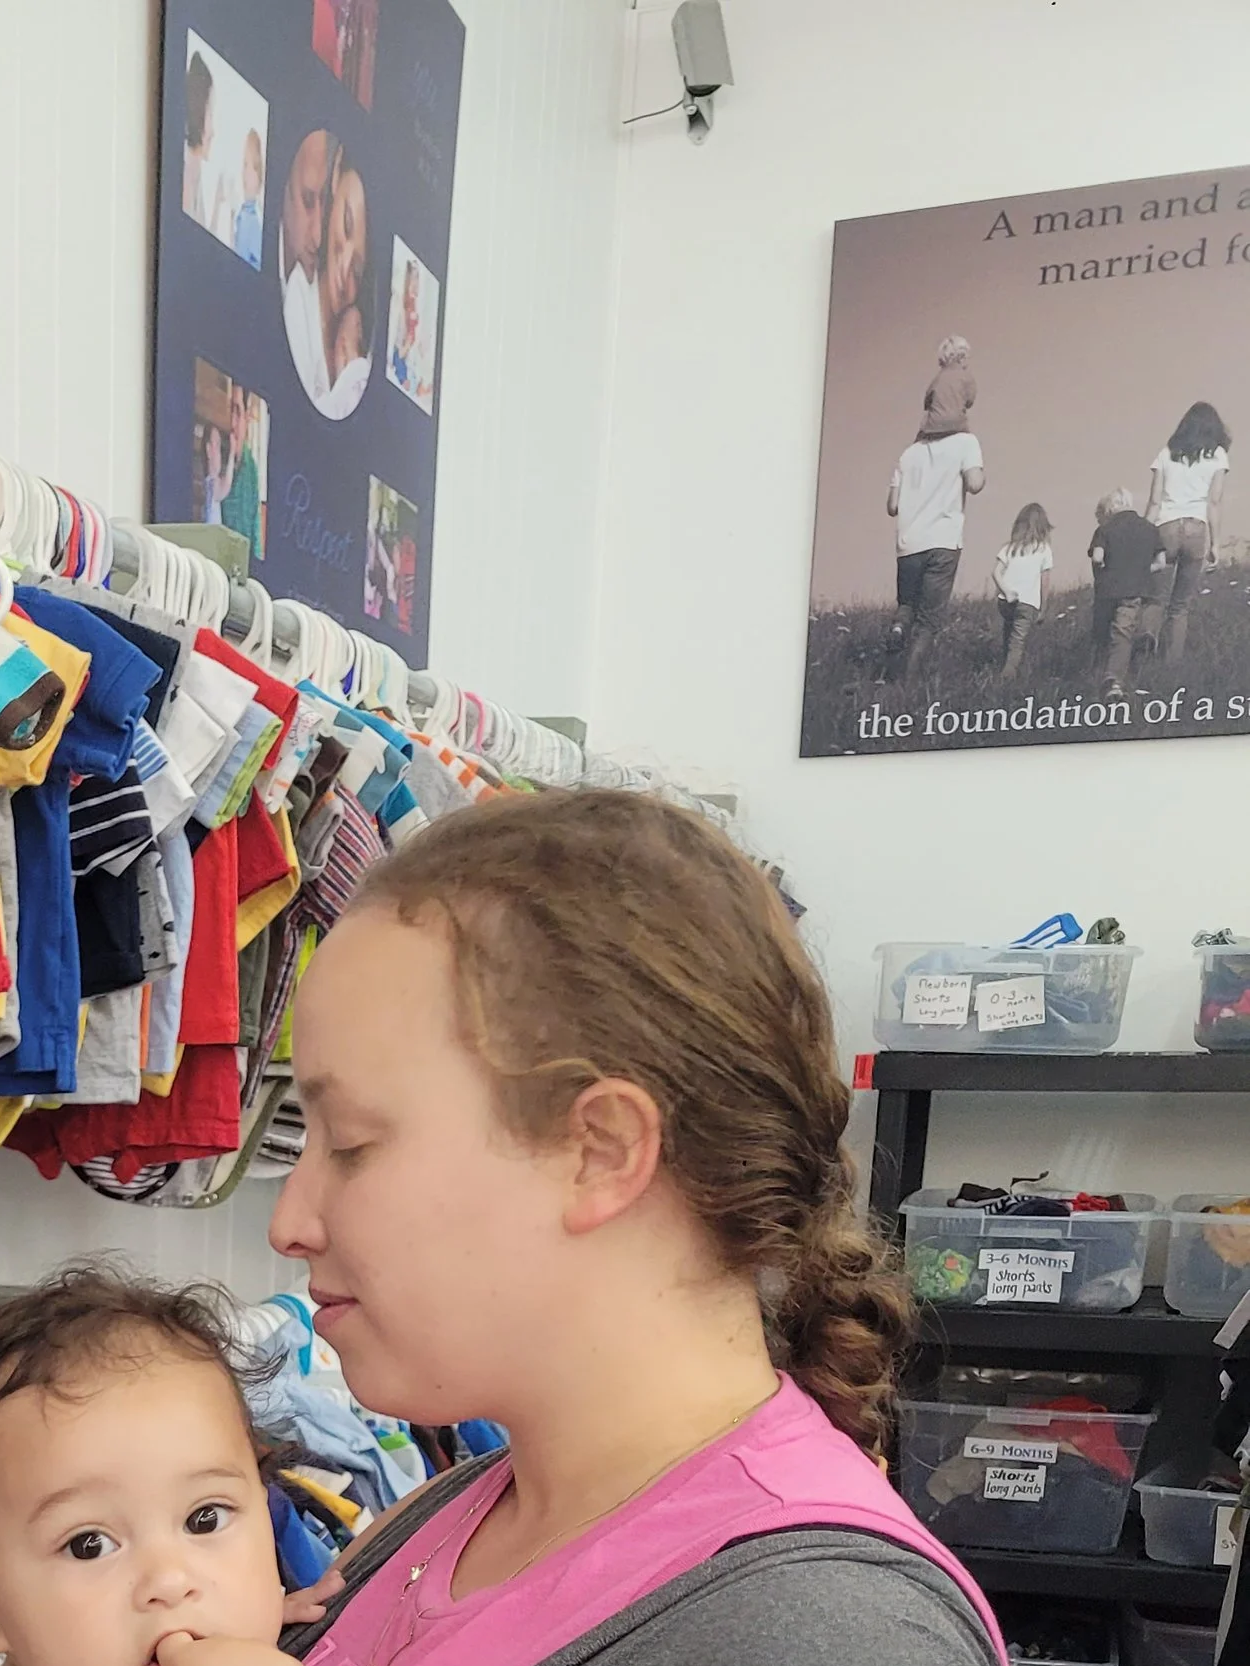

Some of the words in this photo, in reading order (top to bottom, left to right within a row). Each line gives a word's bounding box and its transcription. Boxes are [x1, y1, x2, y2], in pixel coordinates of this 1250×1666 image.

[982, 209, 1017, 242] A
[1033, 203, 1123, 236] man
[1140, 182, 1220, 222] and
[1037, 237, 1208, 286] married
[857, 703, 914, 739] the
[922, 694, 1132, 736] foundation
[1143, 687, 1186, 724] of
[1193, 696, 1214, 721] a
[992, 1282, 1018, 1299] long
[986, 1481, 1010, 1497] long
